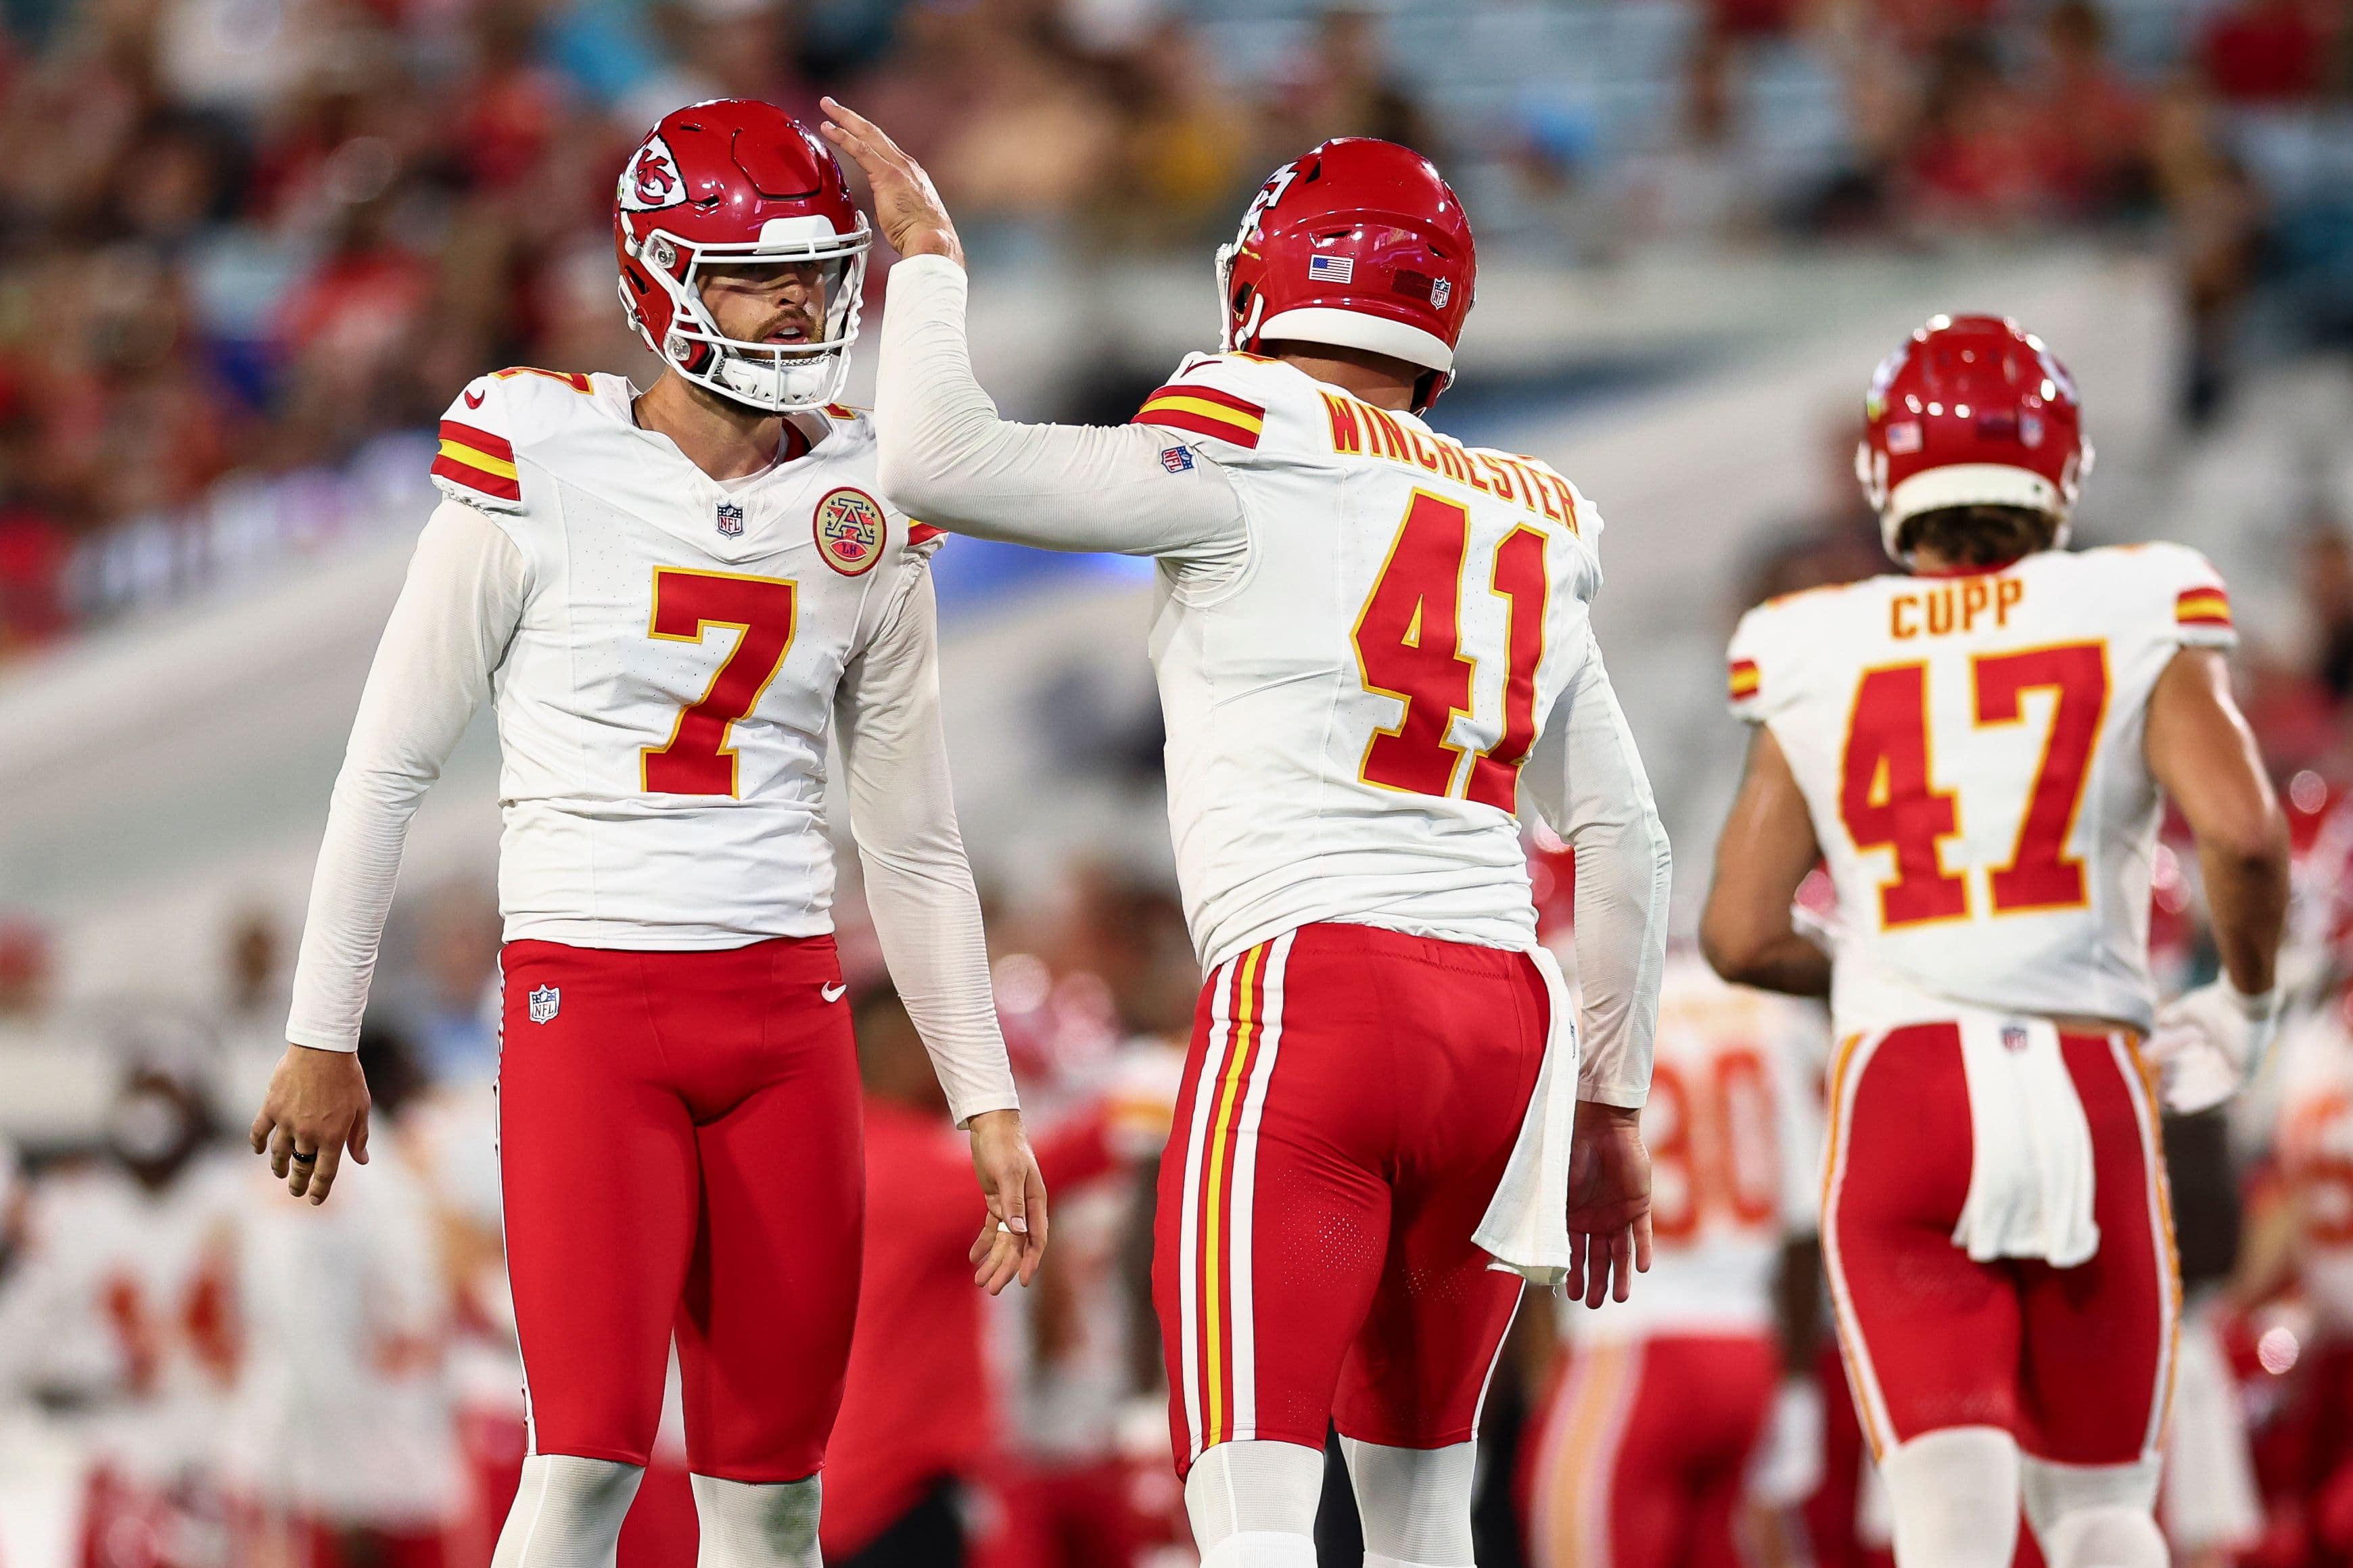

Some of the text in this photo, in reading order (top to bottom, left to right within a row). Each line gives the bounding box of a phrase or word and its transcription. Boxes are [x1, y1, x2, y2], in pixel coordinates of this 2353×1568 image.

[1433, 290, 1447, 305] NFL
[1164, 450, 1182, 471] NFL
[1316, 388, 1581, 540] WINCHESTER
[718, 516, 741, 533] NFL
[1890, 577, 2023, 640] CUPP
[640, 565, 799, 800] 7
[1349, 486, 1550, 819] 41
[1838, 638, 2112, 933] 47
[534, 1003, 554, 1017] NFL
